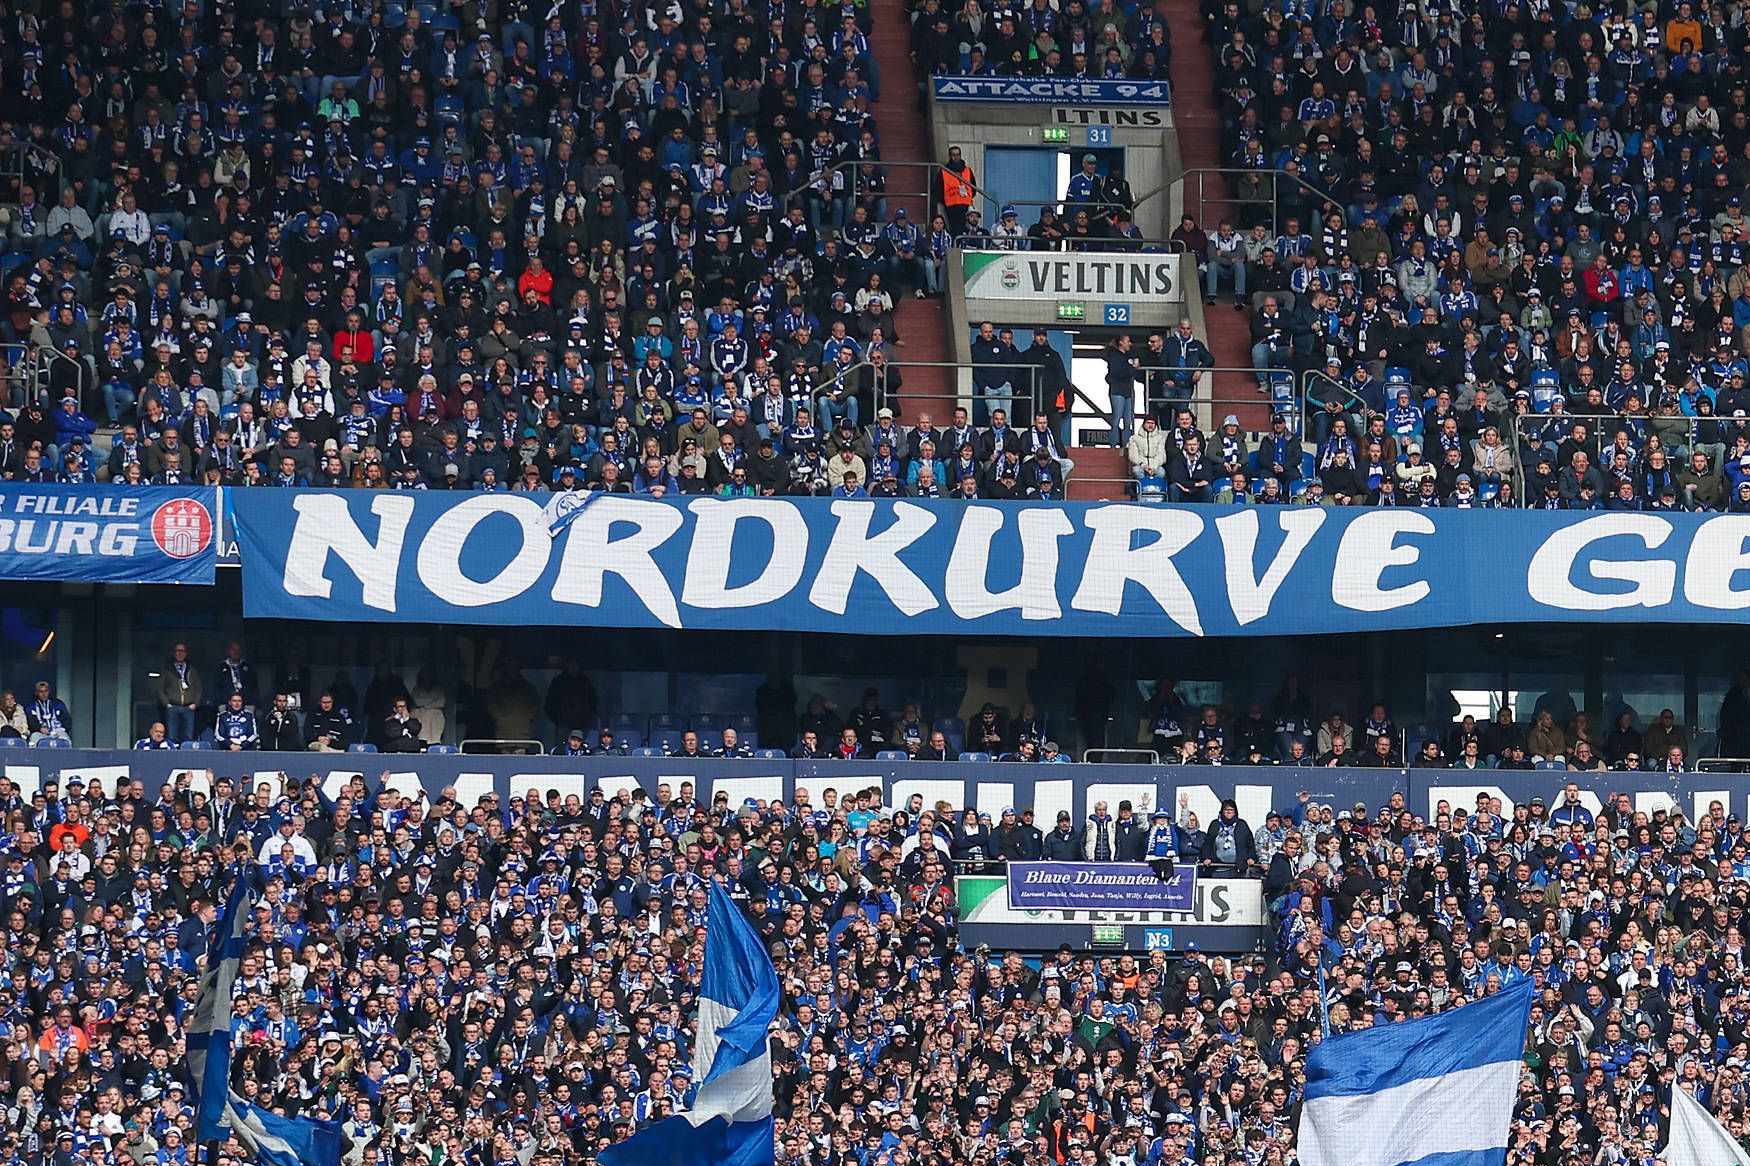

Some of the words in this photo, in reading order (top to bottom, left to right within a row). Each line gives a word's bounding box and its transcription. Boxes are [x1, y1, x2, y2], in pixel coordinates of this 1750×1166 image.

[938, 81, 1101, 97] ATTACKE
[1116, 85, 1163, 98] 94
[1090, 129, 1108, 142] 31
[1028, 261, 1172, 295] VELTINS
[1108, 308, 1127, 321] 32
[15, 495, 140, 516] FILIALE
[283, 493, 1436, 637] NORDKURVE
[1024, 871, 1070, 885] Blaue
[1074, 871, 1158, 886] Diamanten
